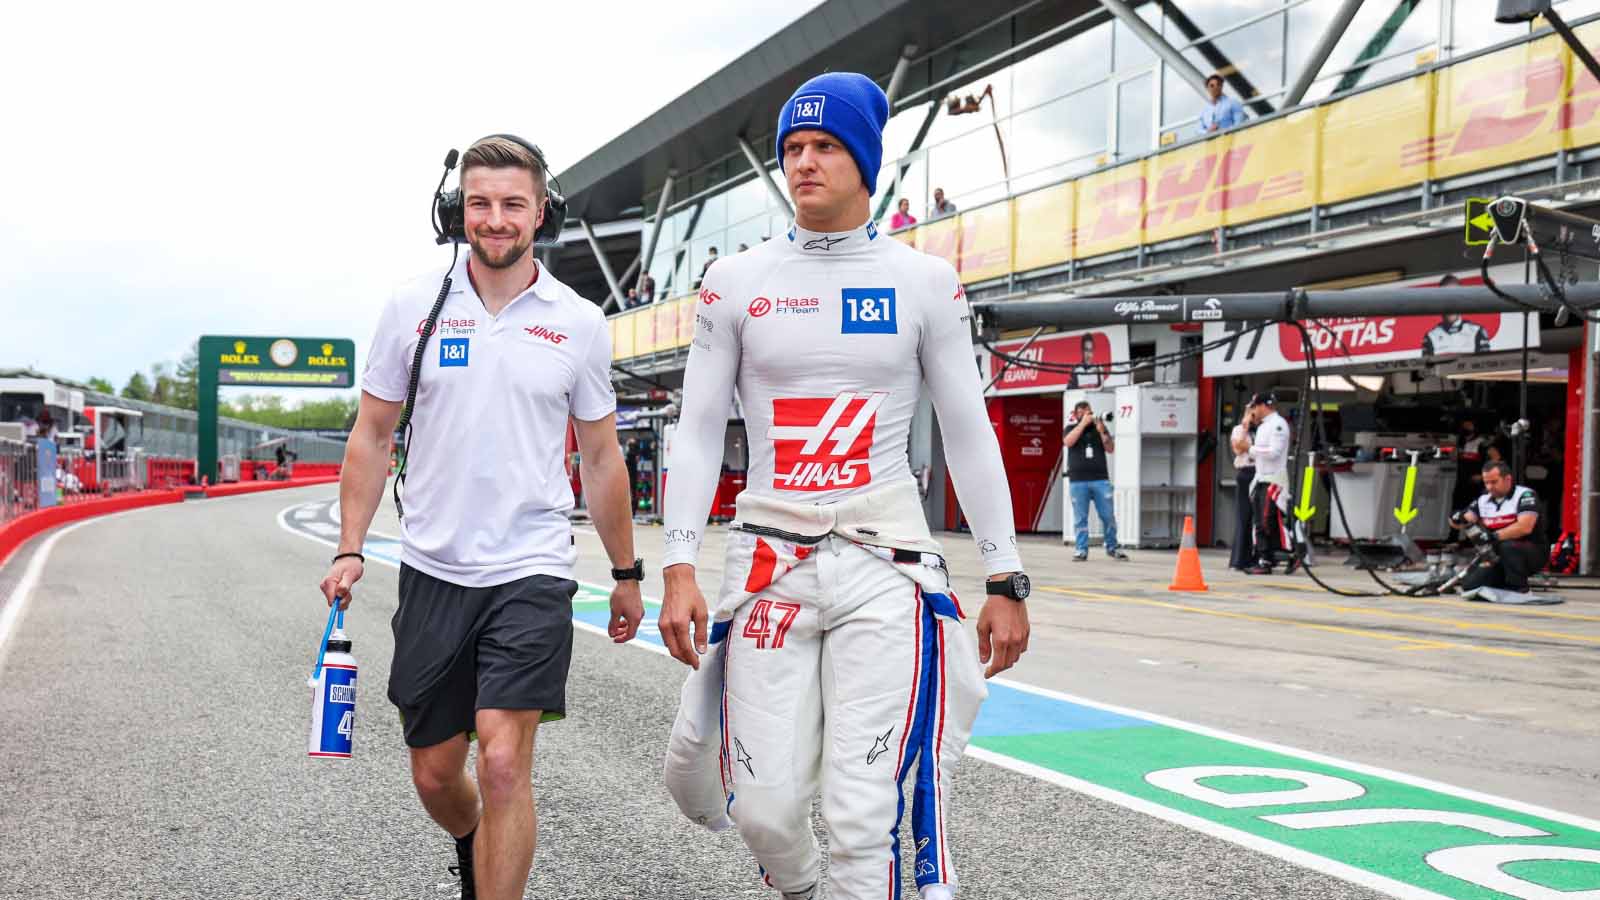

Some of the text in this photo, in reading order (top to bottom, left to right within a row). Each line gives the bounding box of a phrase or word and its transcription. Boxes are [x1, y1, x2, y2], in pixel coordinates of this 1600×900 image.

[796, 101, 820, 117] 1&1
[1091, 144, 1265, 241] DHL
[776, 297, 819, 307] Haas
[787, 306, 820, 314] Team
[846, 298, 891, 322] 1&1
[440, 318, 476, 328] Haas
[523, 325, 568, 345] HAAS
[1224, 319, 1268, 362] 77
[220, 354, 260, 365] ROLEX
[442, 344, 465, 360] 1&1
[308, 356, 348, 367] ROLEX
[773, 459, 868, 488] HAAS
[743, 599, 801, 649] 47
[337, 711, 355, 741] 4
